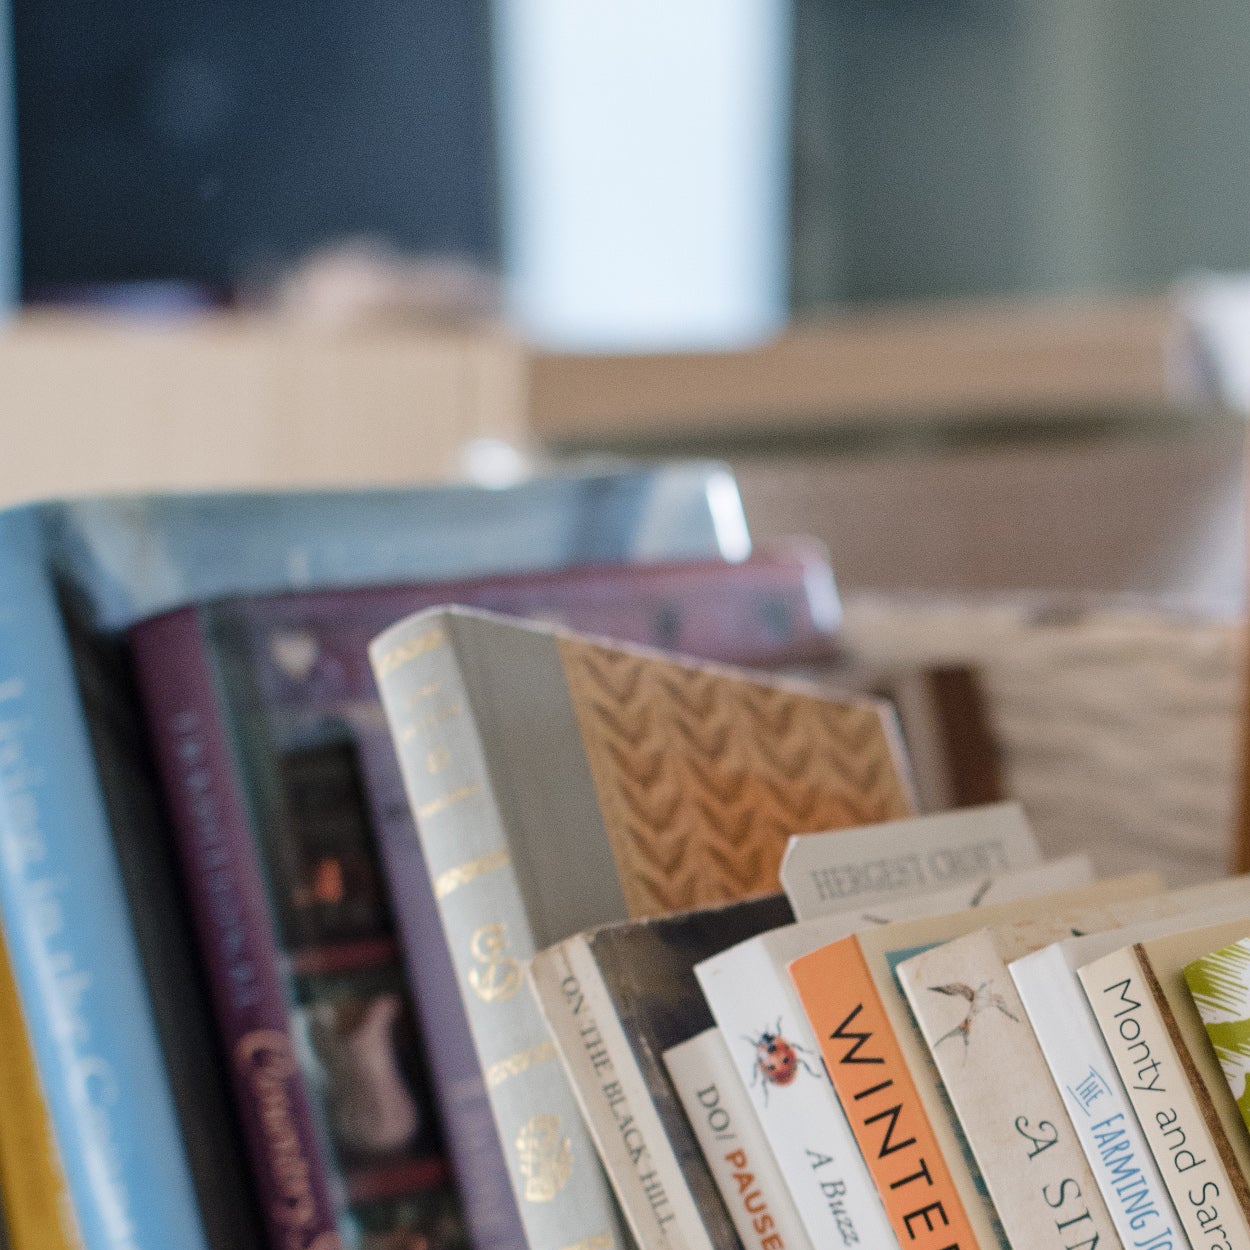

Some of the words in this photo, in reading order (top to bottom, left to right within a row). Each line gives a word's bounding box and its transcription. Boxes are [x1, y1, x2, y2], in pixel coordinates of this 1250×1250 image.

[561, 975, 588, 1016] ON
[579, 1018, 614, 1077] THE
[602, 1080, 650, 1164] BLACK
[1075, 1071, 1103, 1108] THE
[1103, 978, 1166, 1093] Monty
[1155, 1108, 1206, 1173] and
[1015, 1115, 1060, 1161] A
[1090, 1113, 1160, 1231] FARMING
[805, 1148, 834, 1170] A
[820, 1179, 860, 1247] Buzz
